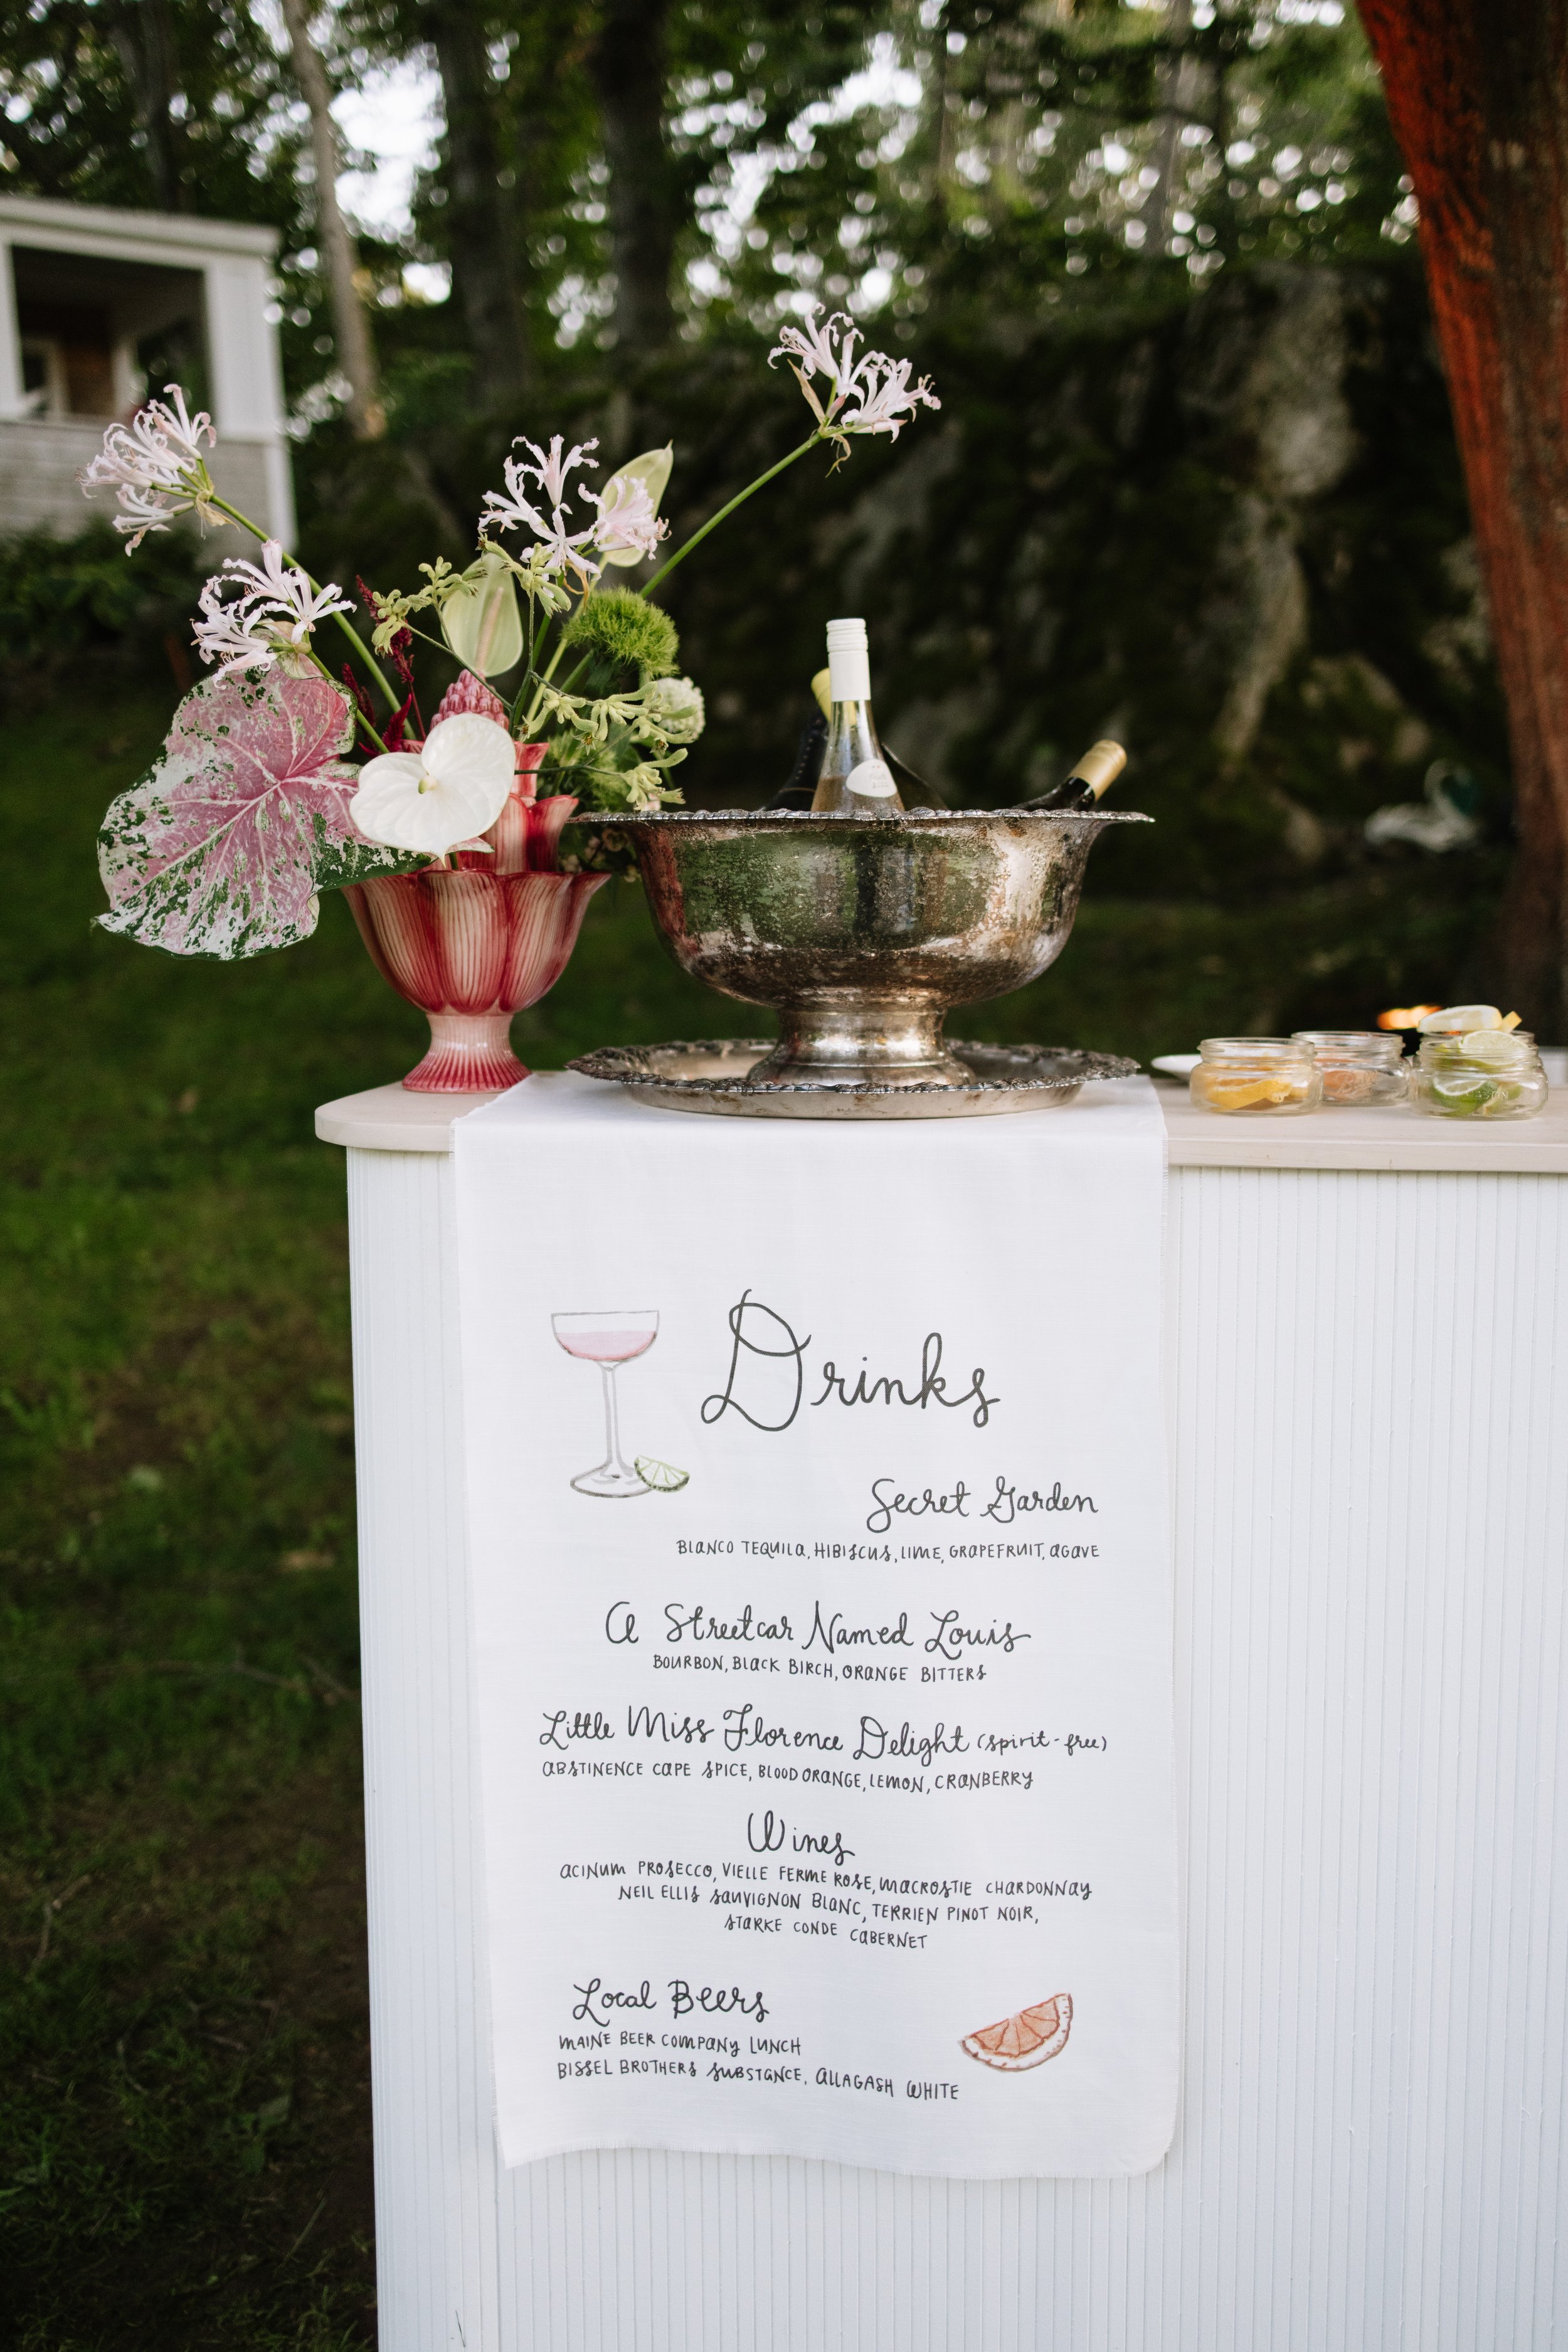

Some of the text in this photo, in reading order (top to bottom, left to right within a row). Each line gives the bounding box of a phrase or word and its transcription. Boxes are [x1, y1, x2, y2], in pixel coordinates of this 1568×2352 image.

[700, 1288, 1001, 1433] Drinks
[866, 1475, 1099, 1534] Secret Garden
[675, 1539, 734, 1555] BLANCO
[1049, 1543, 1099, 1559] AGAVE
[664, 1602, 794, 1643] Streetcar
[801, 1600, 914, 1655] Named
[924, 1609, 1032, 1661] Louis
[732, 1656, 780, 1673] BLACK
[842, 1665, 909, 1682] ORANGE
[920, 1664, 987, 1683] BITTERS
[539, 1710, 615, 1751] Little
[628, 1705, 715, 1744] Miss
[723, 1703, 844, 1752] Florence
[852, 1715, 970, 1767] Delight
[542, 1760, 644, 1777] ABSTINENCE
[652, 1762, 691, 1777] CAPE
[935, 1770, 1034, 1791] CRANBERRY
[747, 1809, 856, 1867] Wines
[559, 1862, 627, 1880] ACINUM
[722, 1862, 768, 1880] VIELLE
[779, 1865, 827, 1883] FERME
[879, 1877, 972, 1899] MACROSTIE
[985, 1880, 1093, 1901] CHARDONNAY
[617, 1885, 655, 1900] NEIL
[661, 1884, 701, 1904] ELLIS
[709, 1888, 802, 1910] SAUVIGNON
[871, 1903, 939, 1926] TERRIEN
[947, 1906, 989, 1922] PINOT
[724, 1914, 928, 1949] STARKE CONDE CABERNET
[572, 1978, 770, 2028] Local Beers
[559, 2030, 802, 2058] MAINE BEER COMPANY LUNCH
[557, 2059, 613, 2080] BISSEL
[619, 2059, 697, 2077] BROTHERS
[815, 2067, 894, 2098] ALLAGASH
[906, 2080, 959, 2100] WHITE
